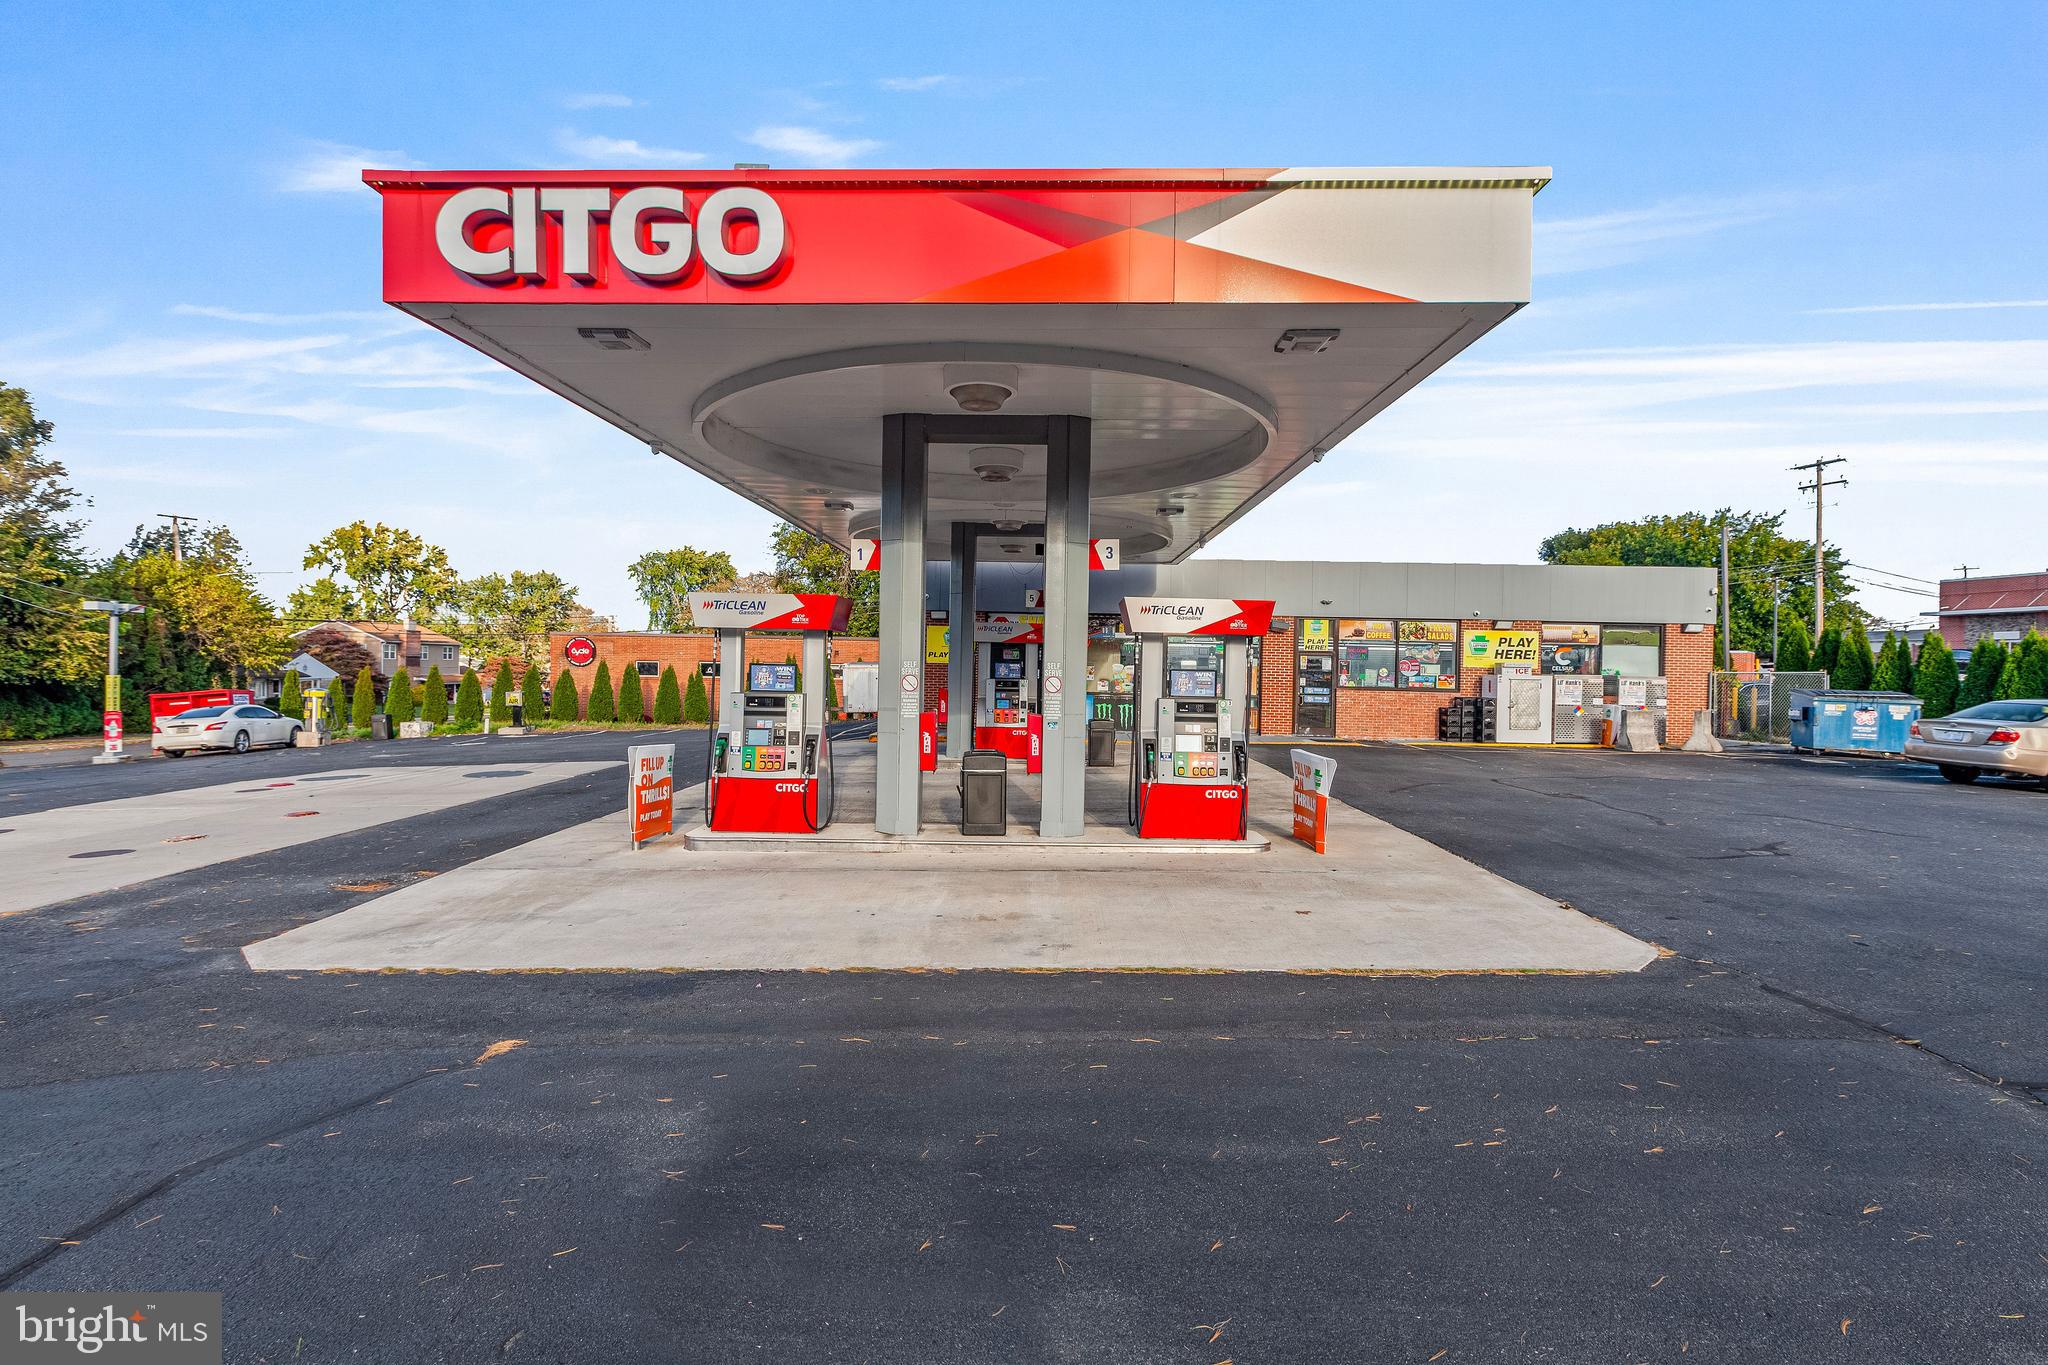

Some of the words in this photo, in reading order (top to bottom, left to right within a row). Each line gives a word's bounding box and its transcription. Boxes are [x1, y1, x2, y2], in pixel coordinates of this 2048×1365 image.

[435, 186, 786, 280] CITGO
[857, 547, 863, 560] 1
[1105, 546, 1114, 560] 3
[1030, 594, 1035, 602] 5
[713, 600, 766, 611] TriCLEAN
[1150, 605, 1204, 616] TriCLEAN
[1498, 638, 1534, 647] PLAY
[1494, 650, 1536, 660] HERE!
[641, 758, 655, 772] FILL
[656, 756, 664, 770] UP
[1294, 761, 1304, 776] FILL
[1304, 764, 1311, 779] UP
[641, 774, 654, 786] ON
[1205, 790, 1238, 798] CITGO
[640, 812, 650, 822] PLAY
[651, 810, 662, 820] TODAY
